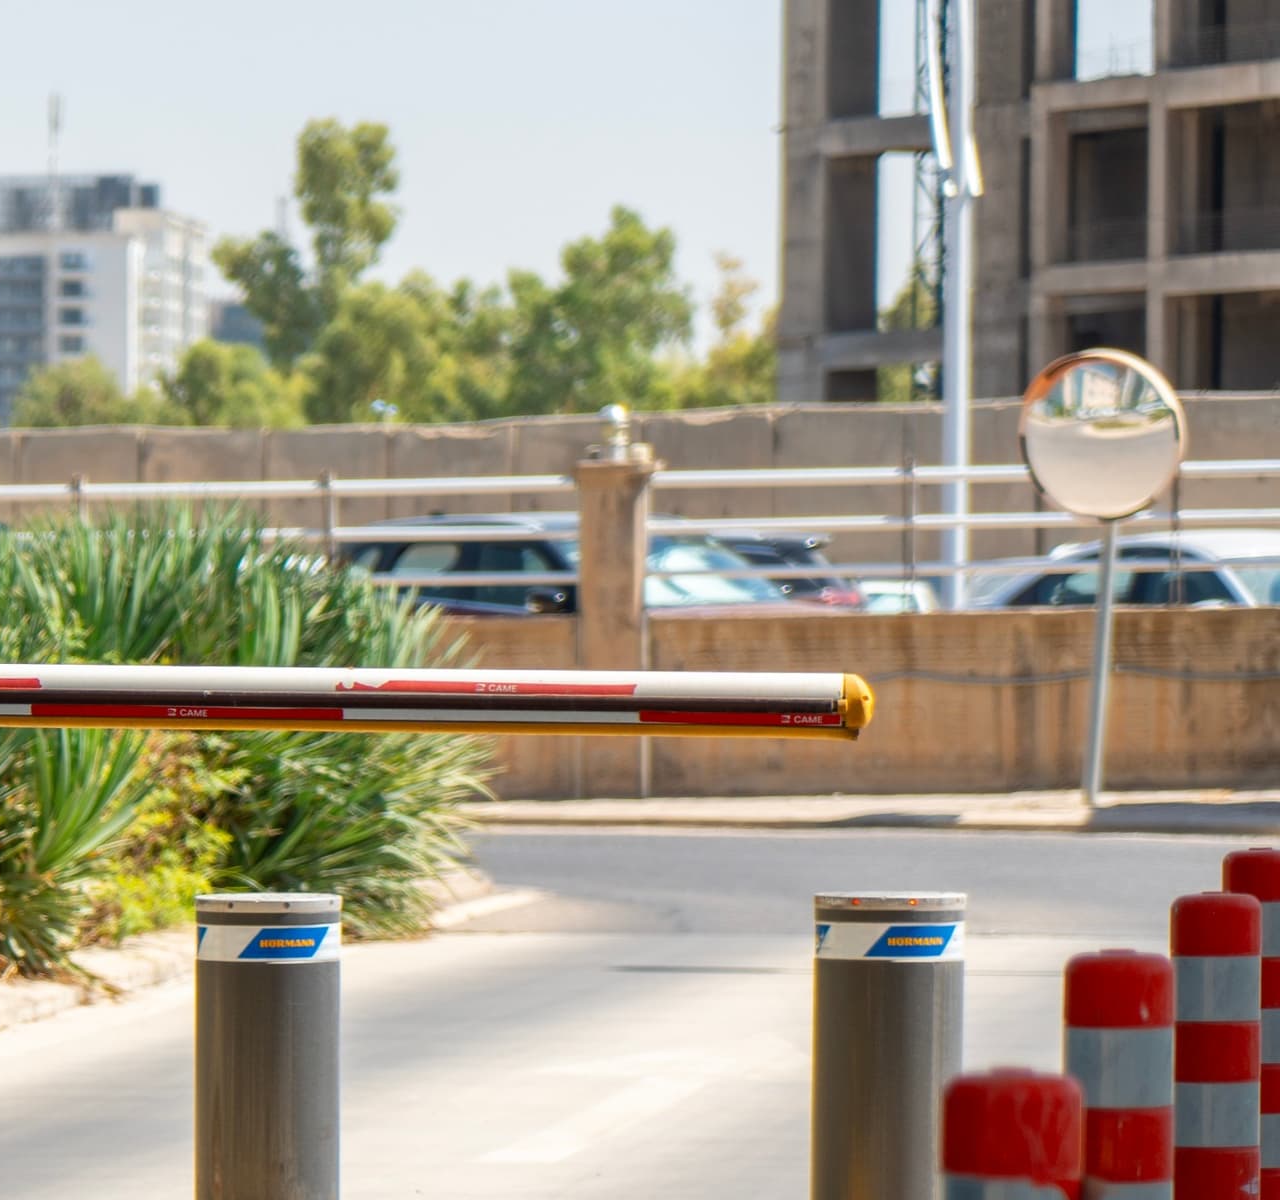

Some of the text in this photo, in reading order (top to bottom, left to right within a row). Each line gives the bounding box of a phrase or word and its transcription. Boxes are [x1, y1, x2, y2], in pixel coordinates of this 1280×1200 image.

[488, 684, 518, 693] CAME
[179, 708, 208, 717] CAME
[793, 714, 823, 724] CAME
